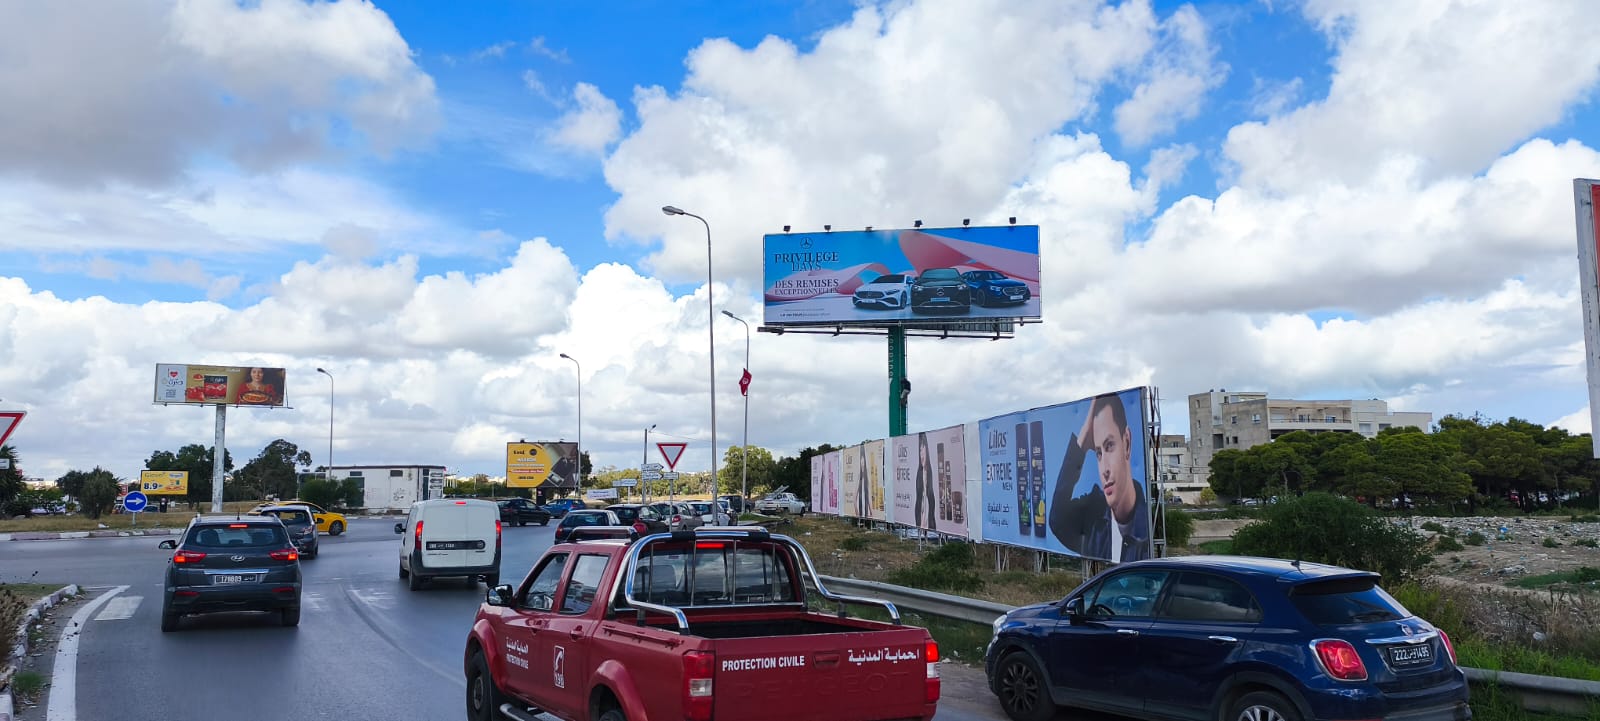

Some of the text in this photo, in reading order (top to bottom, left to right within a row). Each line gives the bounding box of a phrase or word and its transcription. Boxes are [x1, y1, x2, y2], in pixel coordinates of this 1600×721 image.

[774, 252, 840, 263] PRIVILEGE
[792, 261, 821, 271] DAYS
[775, 278, 839, 289] DES REMISES
[774, 287, 838, 296] EXCEPTIONNELLES
[989, 429, 1007, 450] Lilas
[986, 462, 1012, 481] EXTREME
[1002, 482, 1013, 491] MEN
[847, 649, 884, 666] المدنية
[722, 655, 805, 672] PROTECTION CIVILE
